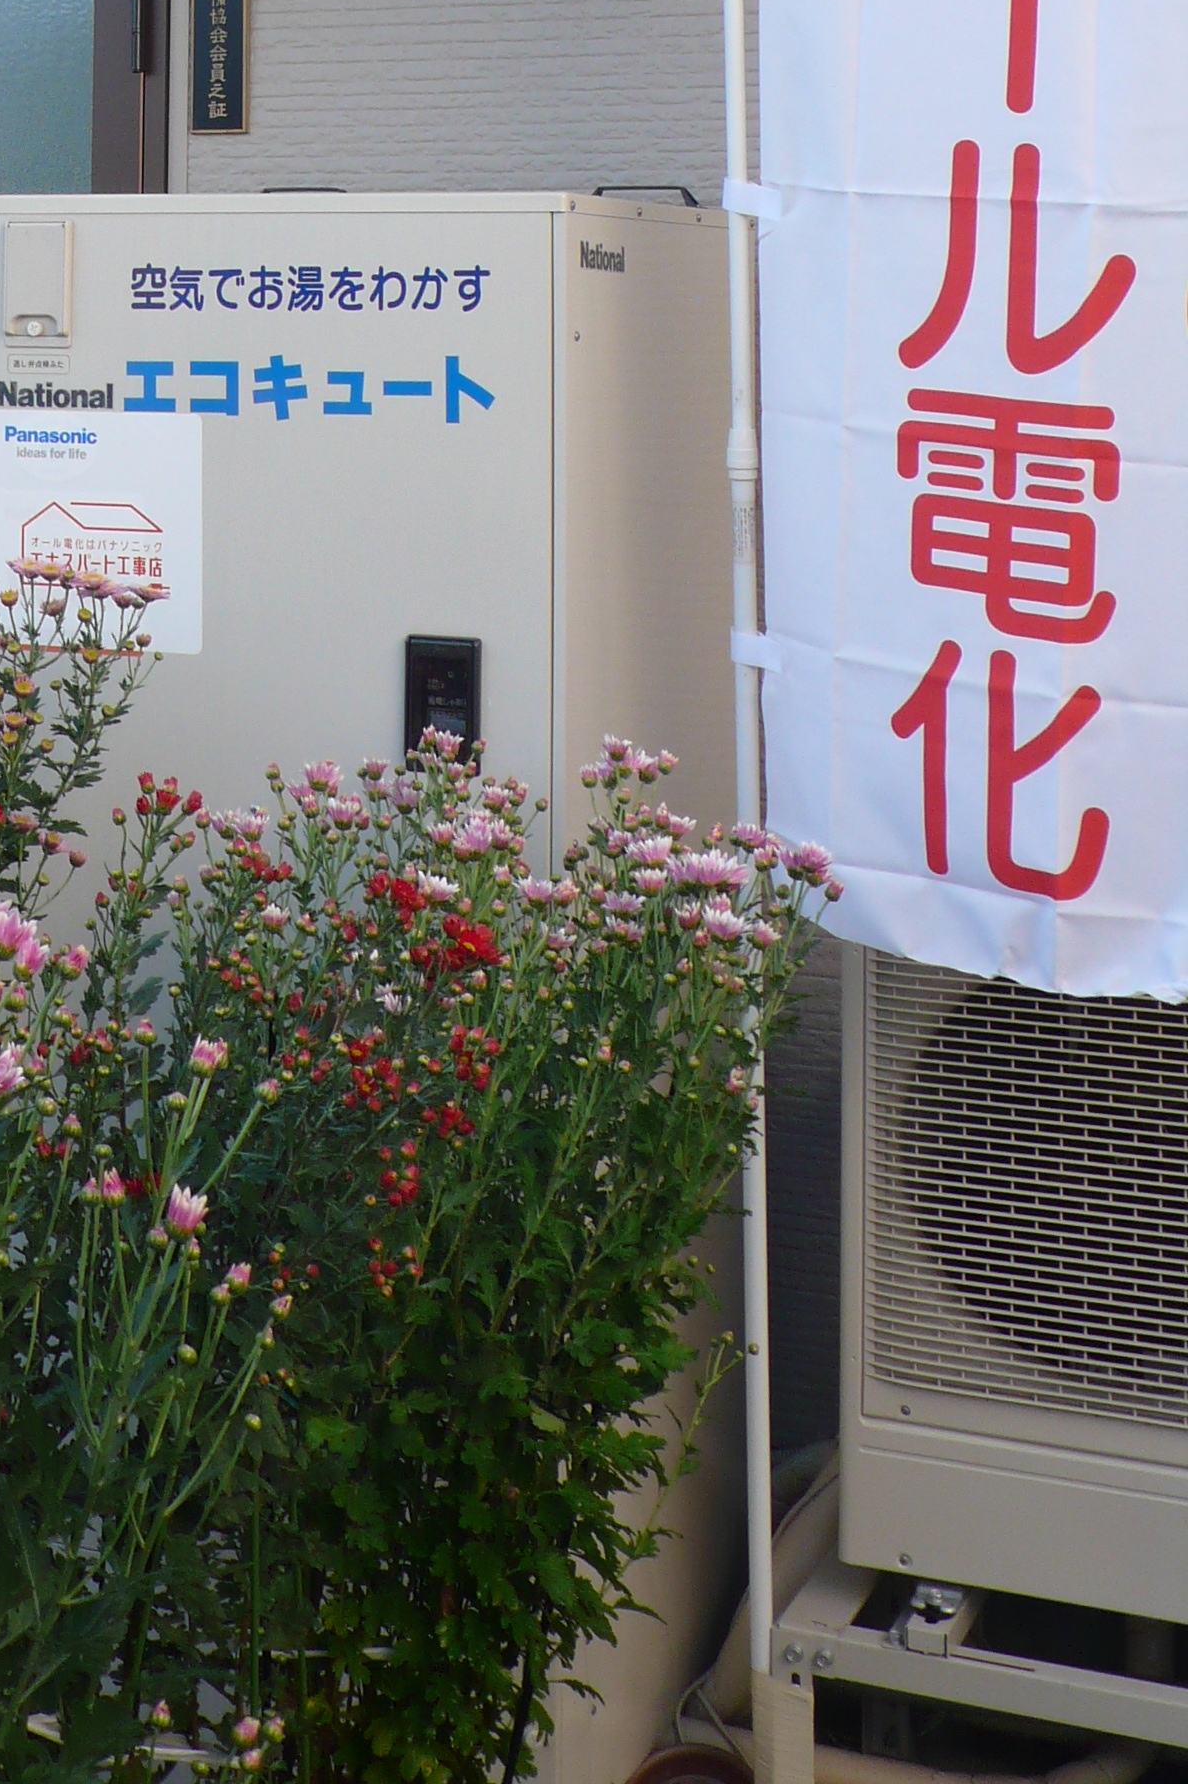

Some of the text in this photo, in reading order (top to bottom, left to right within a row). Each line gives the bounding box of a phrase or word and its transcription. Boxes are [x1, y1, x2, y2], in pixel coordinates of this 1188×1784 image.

[579, 240, 625, 273] National
[130, 262, 491, 313] 空気でお湯をわかす
[123, 354, 496, 424] エコキュート
[4, 425, 98, 445] Panasonic
[16, 446, 87, 460] ideas for life
[30, 536, 163, 554] オール電化はパナソニック
